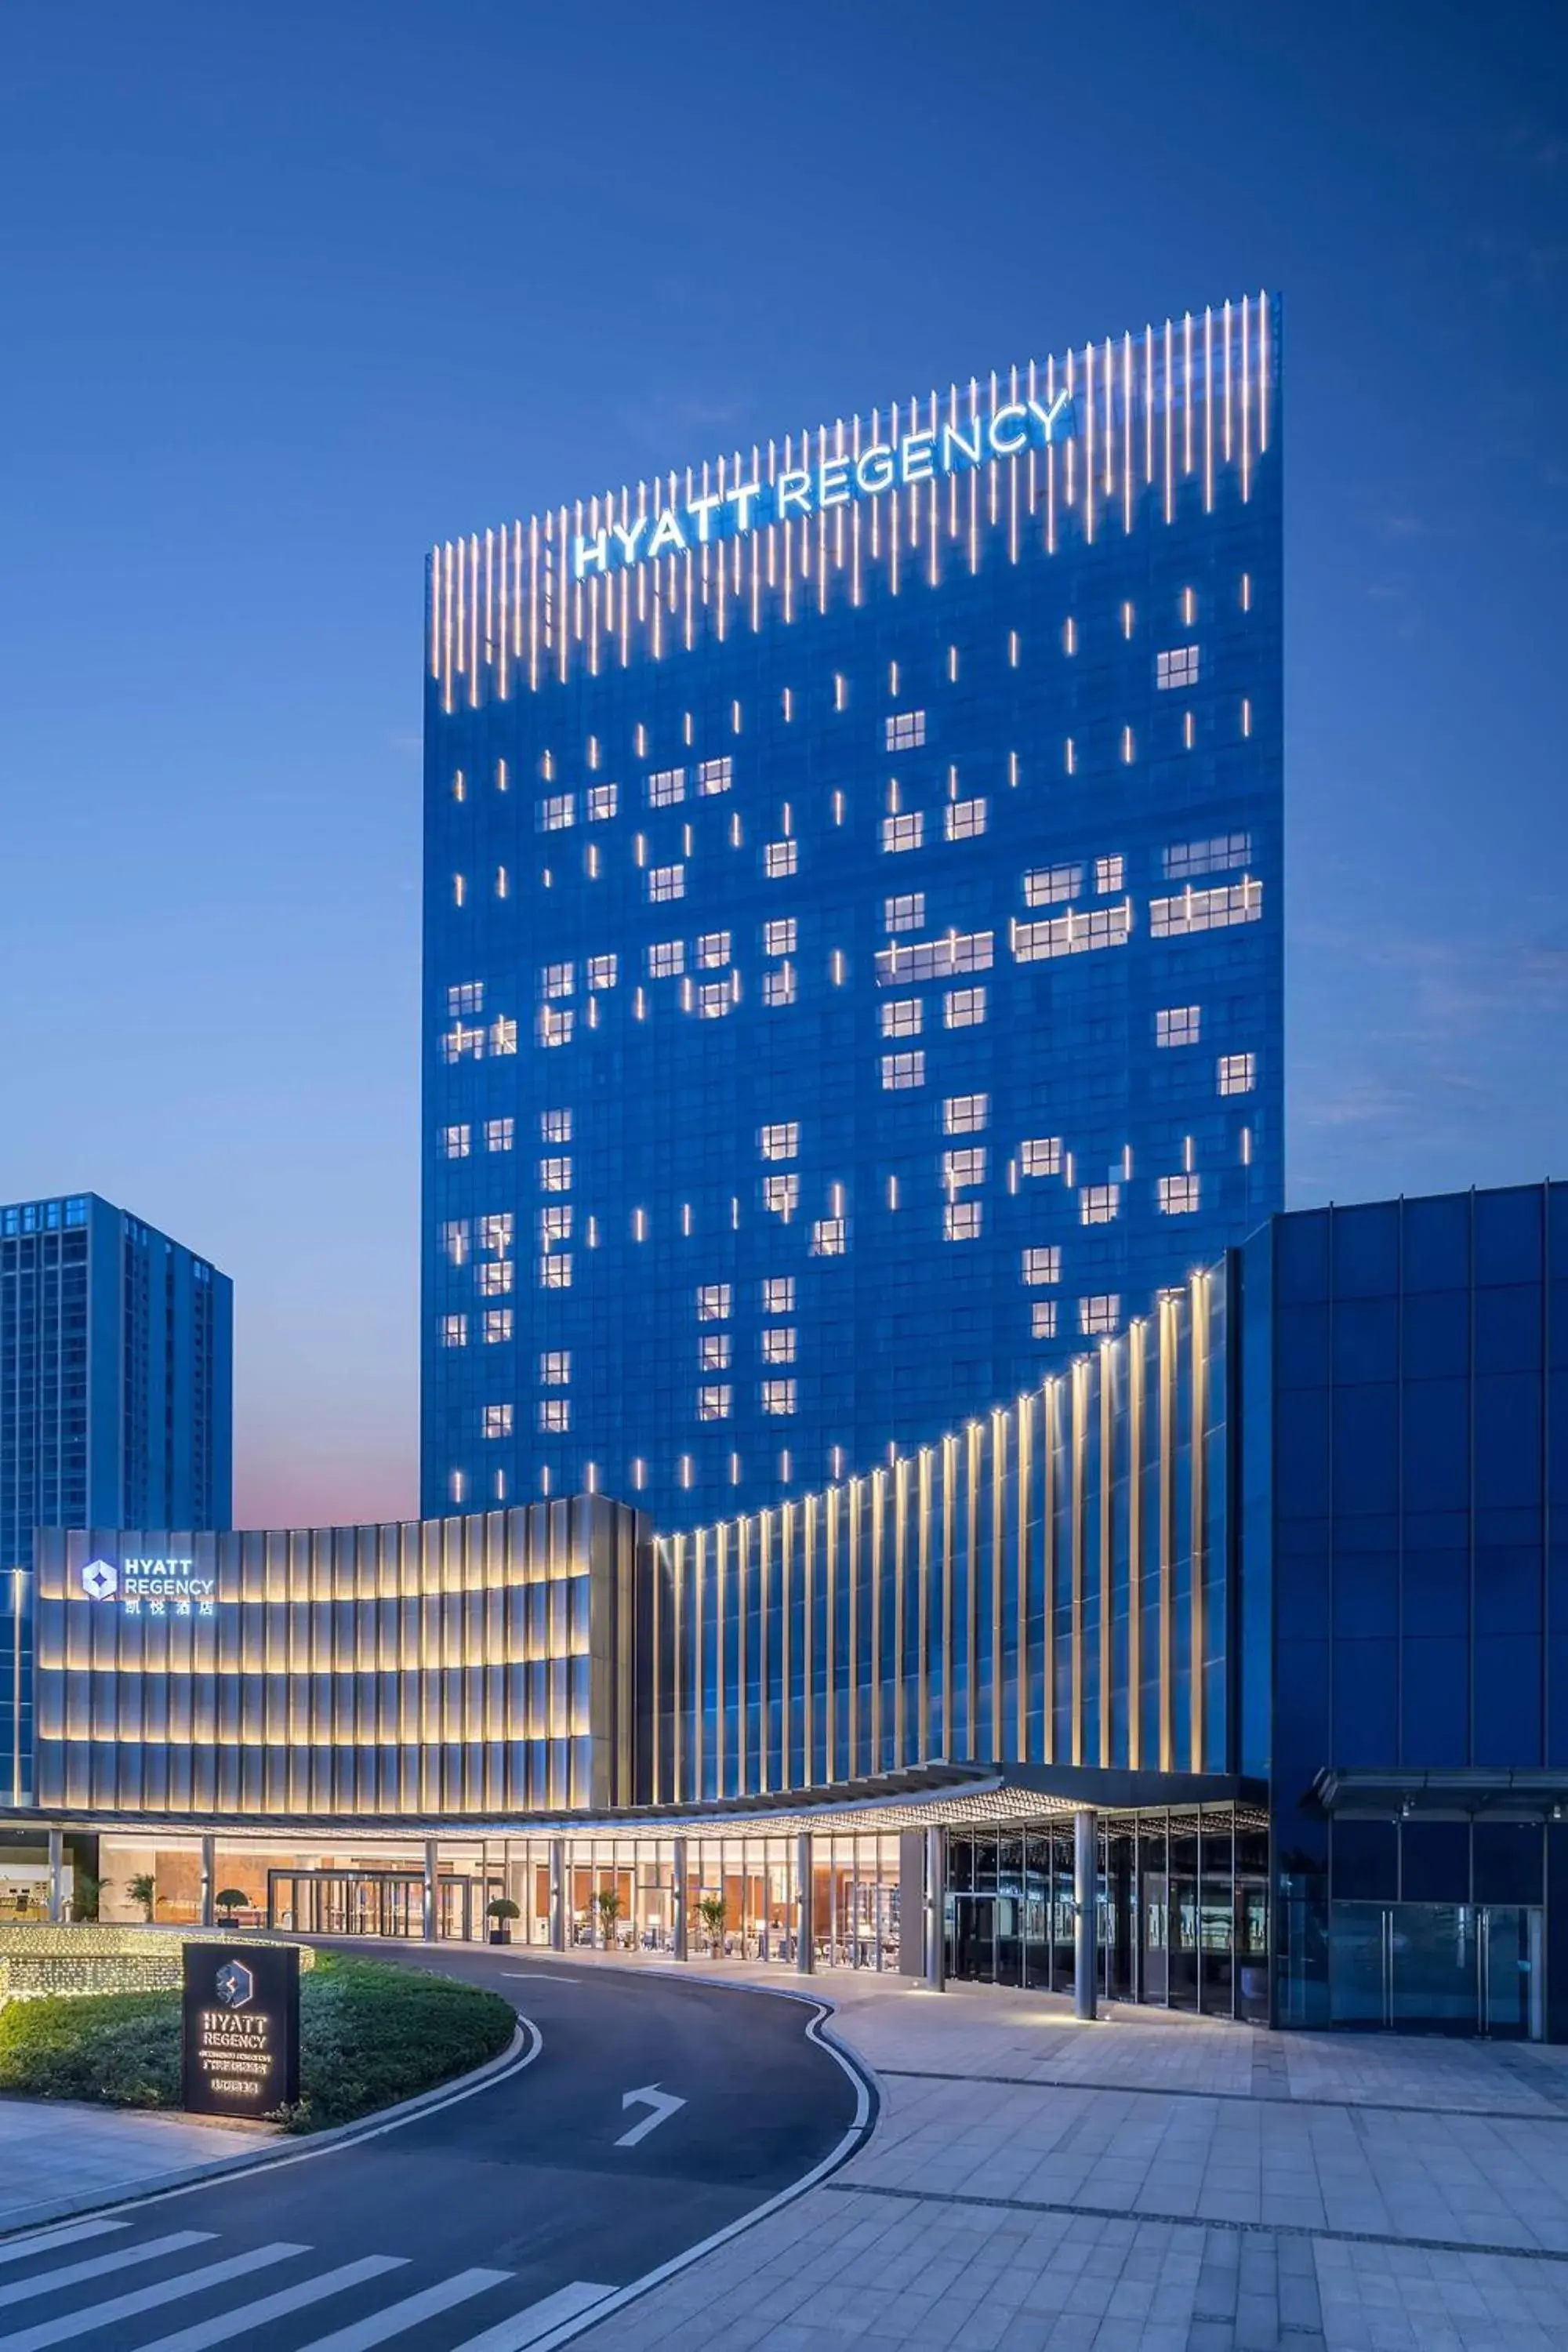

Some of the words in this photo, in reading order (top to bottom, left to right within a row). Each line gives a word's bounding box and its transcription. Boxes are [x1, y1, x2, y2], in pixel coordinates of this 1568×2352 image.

[574, 484, 760, 580] HYATT
[777, 388, 1073, 520] REGENCY
[125, 1559, 193, 1575] HYATT
[125, 1579, 214, 1595] REGENCY
[203, 2013, 267, 2034] HYATT
[202, 2031, 267, 2049] REGENCY
